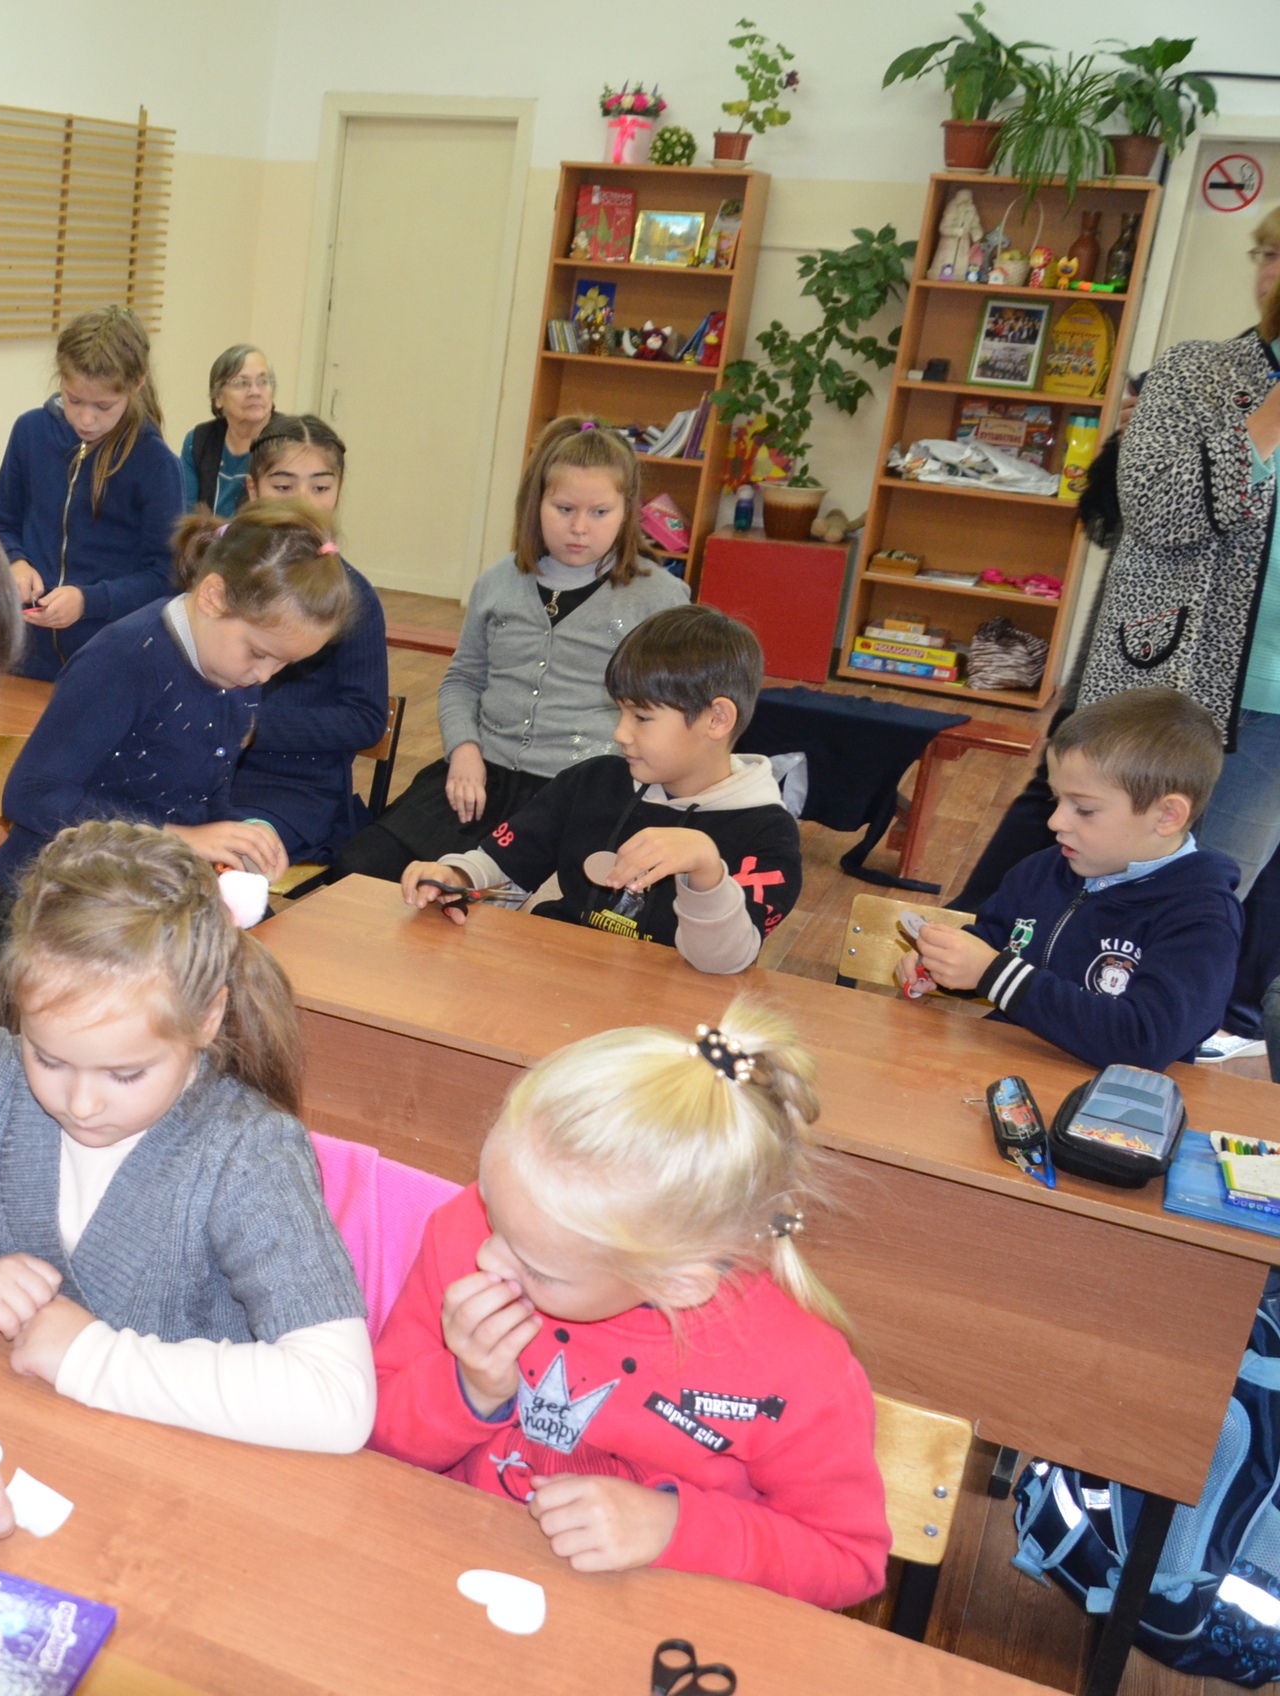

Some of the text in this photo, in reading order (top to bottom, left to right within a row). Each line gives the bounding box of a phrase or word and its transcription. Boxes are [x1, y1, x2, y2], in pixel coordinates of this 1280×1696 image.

[492, 822, 515, 847] 98
[1100, 937, 1142, 960] KIDS
[532, 1395, 570, 1420] get
[694, 1396, 757, 1418] FOREVER
[524, 1407, 580, 1445] happy
[692, 1427, 725, 1450] girl
